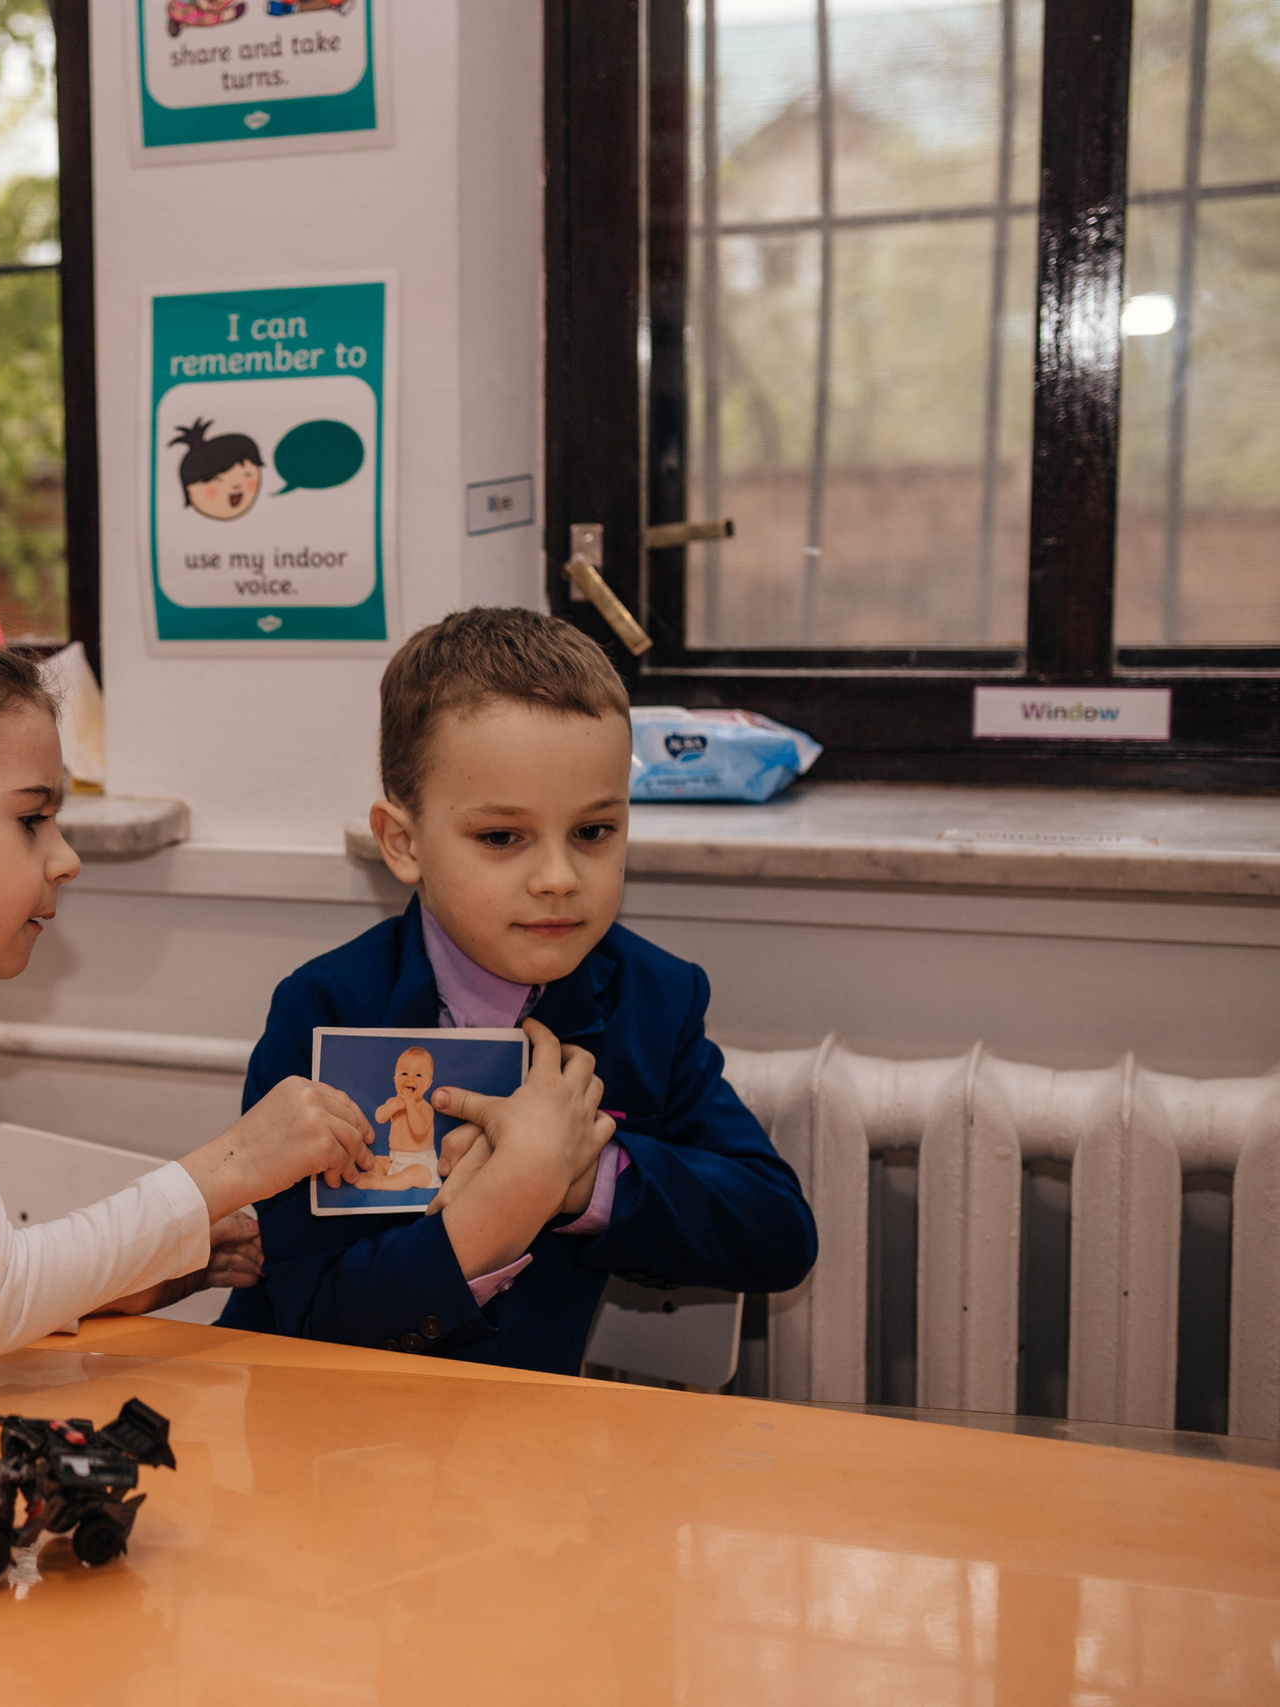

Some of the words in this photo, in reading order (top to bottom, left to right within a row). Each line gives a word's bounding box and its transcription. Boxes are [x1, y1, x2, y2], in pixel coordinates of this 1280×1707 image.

[170, 44, 232, 68] share
[238, 34, 283, 60] and
[291, 30, 342, 55] take
[221, 70, 289, 90] turns.
[227, 313, 240, 342] I
[250, 316, 308, 341] can
[170, 341, 325, 376] remember
[334, 342, 368, 369] to
[184, 553, 222, 570] use
[229, 553, 265, 575] my
[273, 546, 348, 569] indoor
[235, 575, 298, 595] voice.
[1022, 702, 1120, 721] Window
